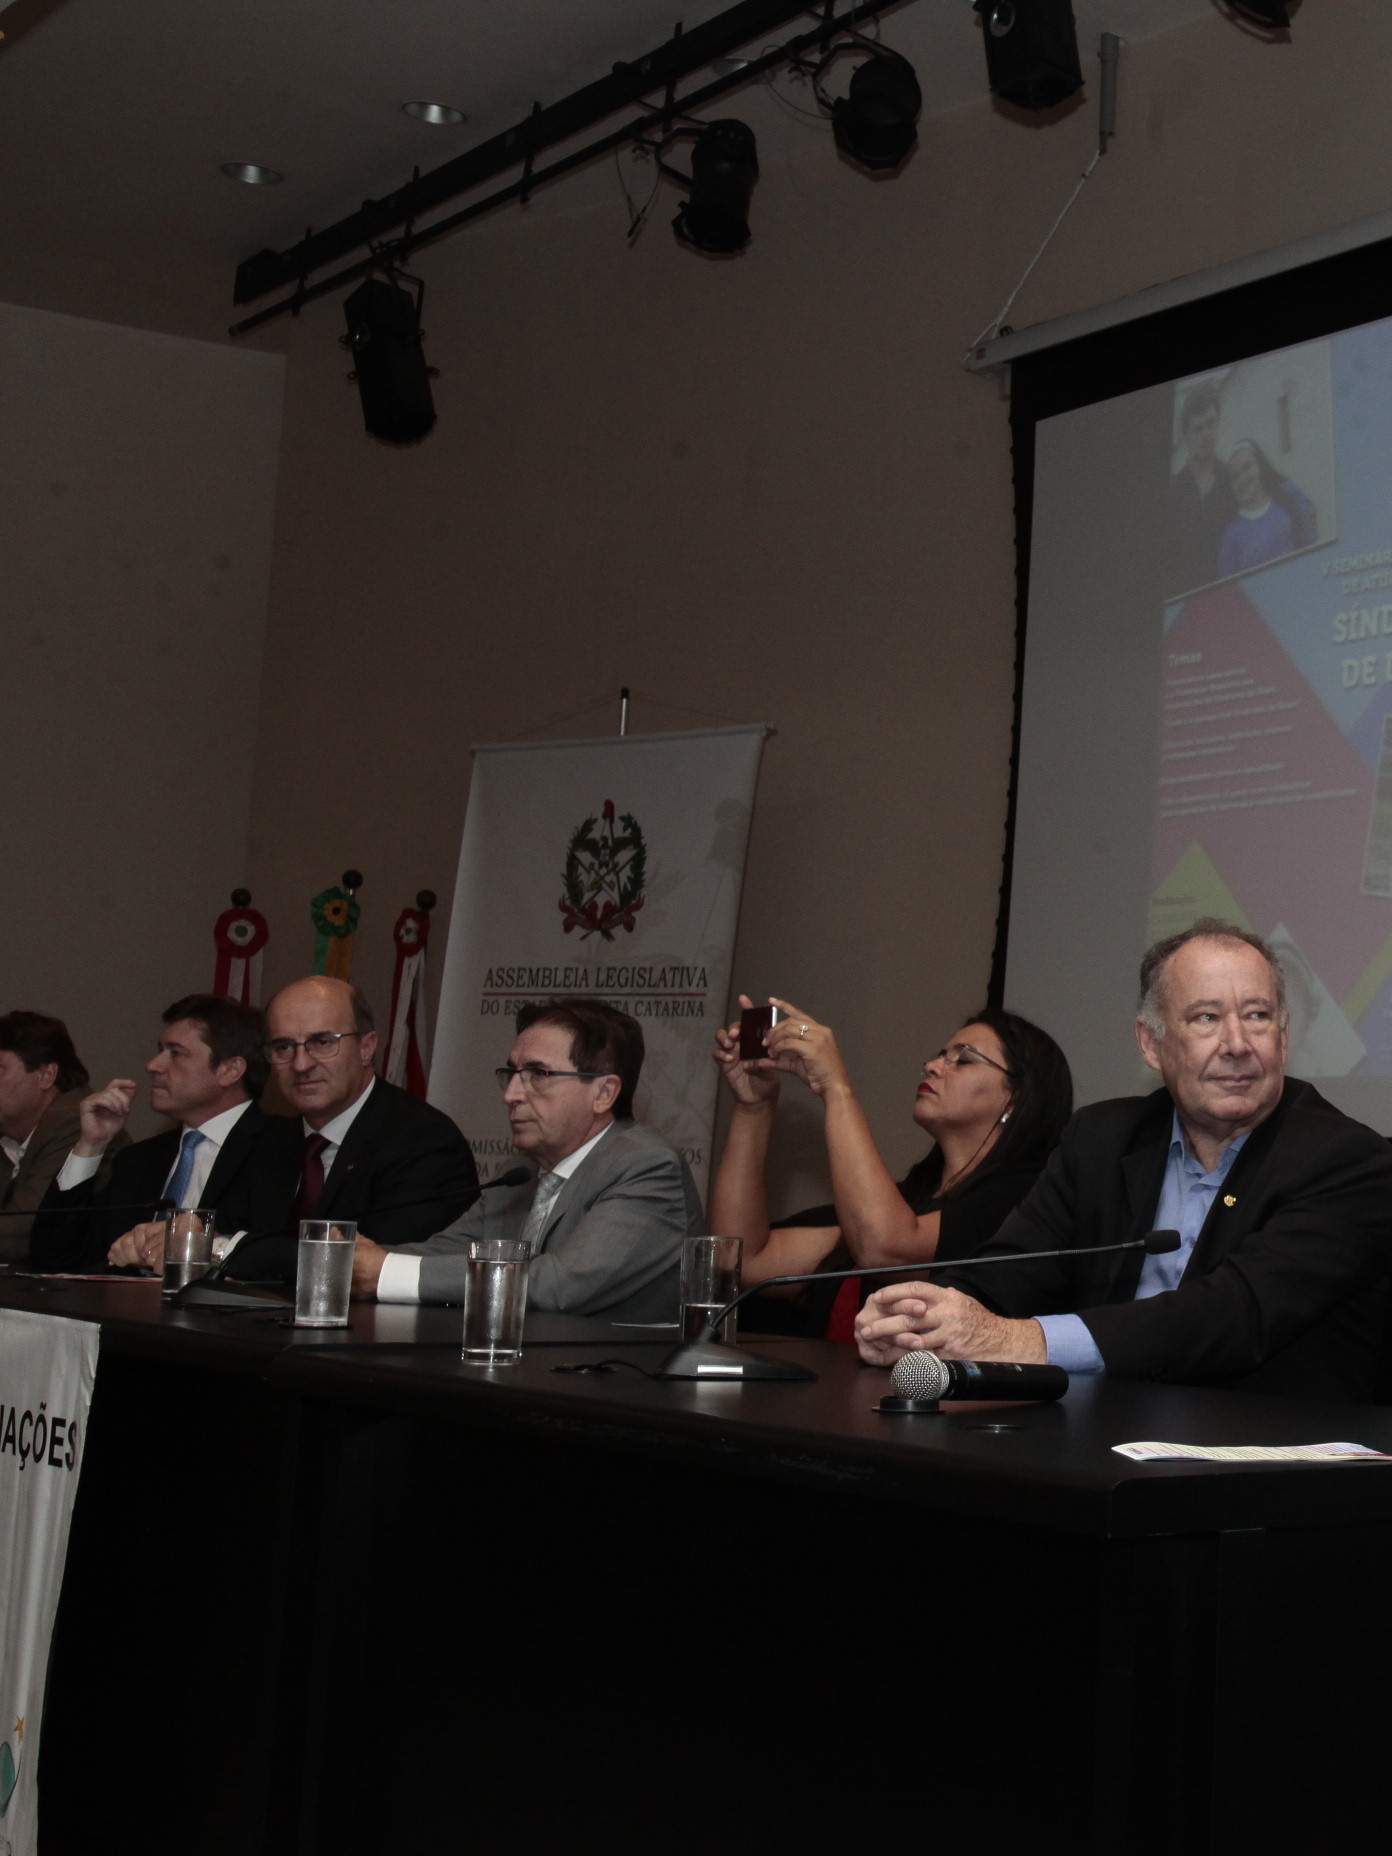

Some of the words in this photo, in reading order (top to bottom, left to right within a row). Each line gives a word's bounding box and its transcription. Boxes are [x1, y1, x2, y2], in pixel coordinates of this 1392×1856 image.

[1342, 654, 1377, 689] DE
[483, 967, 589, 989] ASSEMBLEIA
[594, 966, 708, 989] LEGISLATIVA
[480, 999, 500, 1016] DO
[634, 1000, 706, 1017] CATARINA
